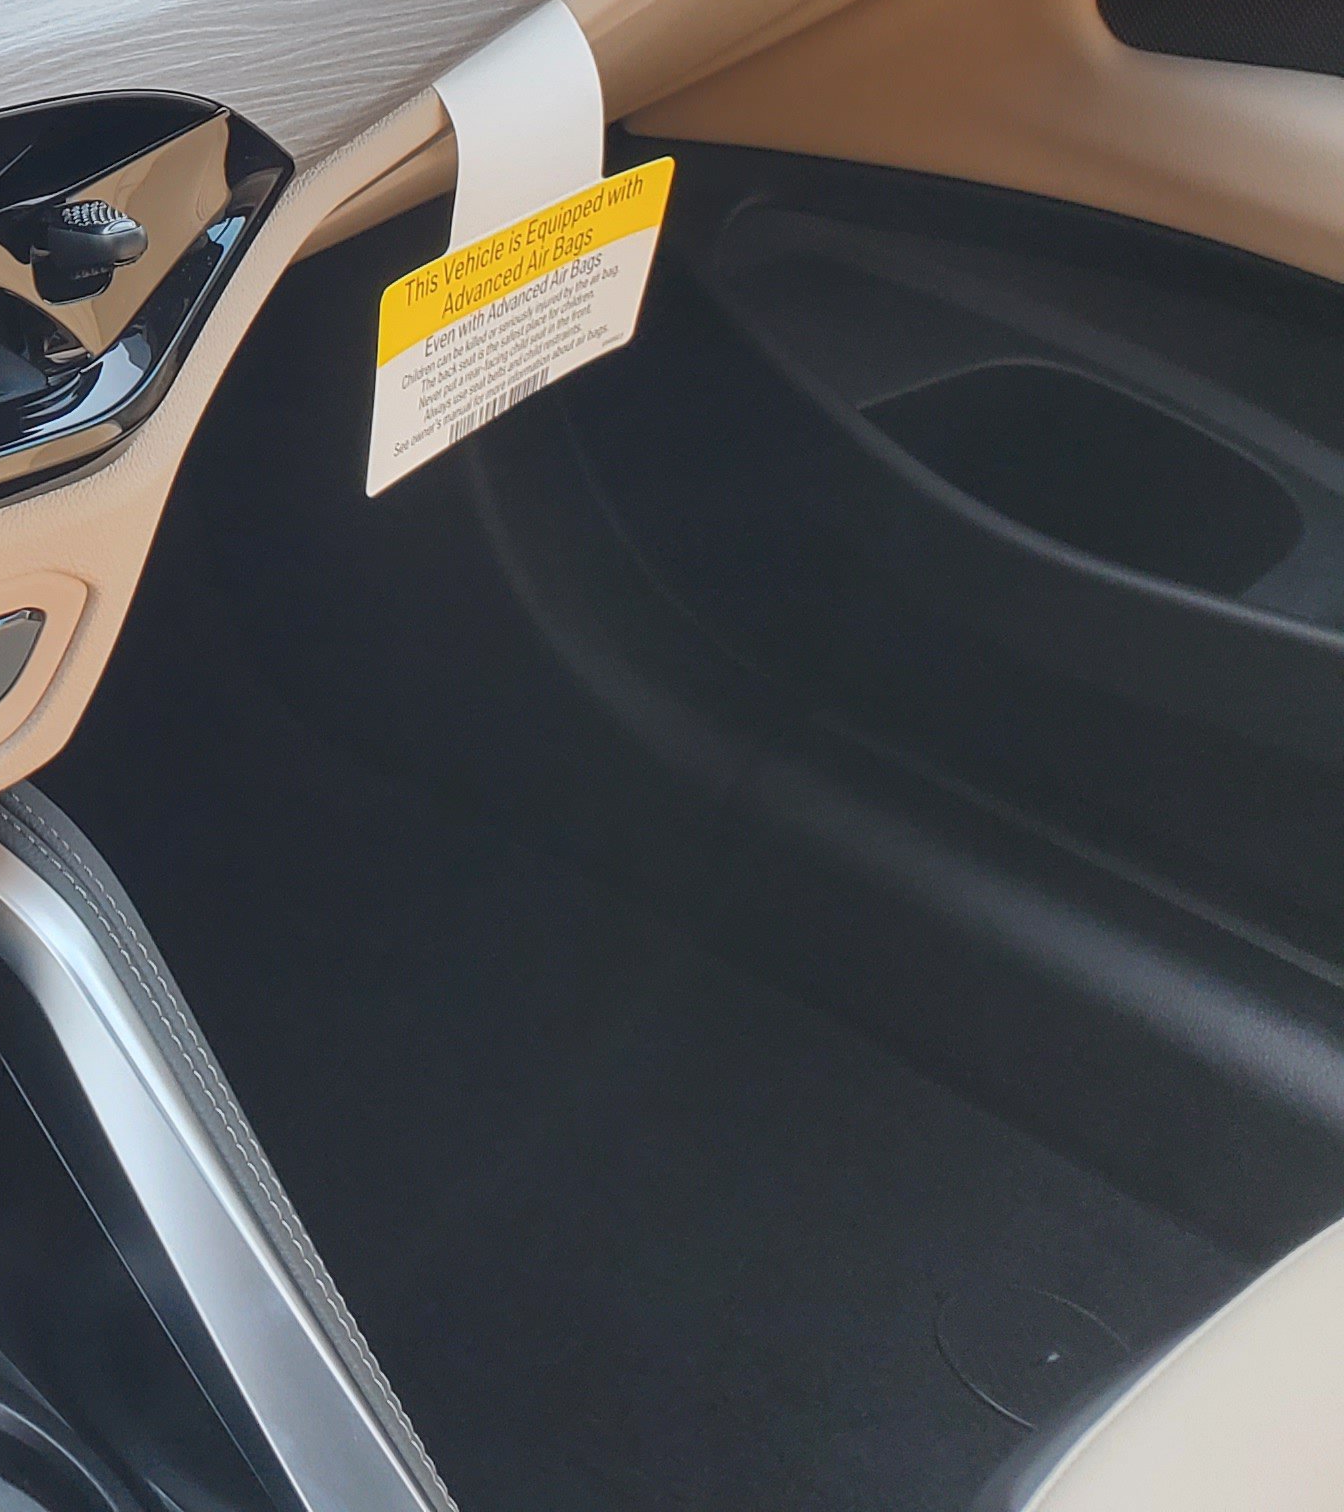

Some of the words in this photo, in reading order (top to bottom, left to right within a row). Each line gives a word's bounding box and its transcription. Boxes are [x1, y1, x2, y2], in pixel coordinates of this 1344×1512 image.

[405, 270, 439, 306] This
[443, 239, 504, 285] Vehicle
[508, 230, 522, 254] is
[526, 187, 605, 246] Equipped
[607, 173, 644, 207] with
[441, 255, 524, 320] Advanced
[525, 245, 550, 275] Air
[552, 228, 593, 262] Bags
[424, 328, 455, 357] Even
[458, 309, 484, 338] with
[486, 273, 549, 324] Advanced
[549, 266, 569, 290] Air
[570, 252, 603, 279] Bags
